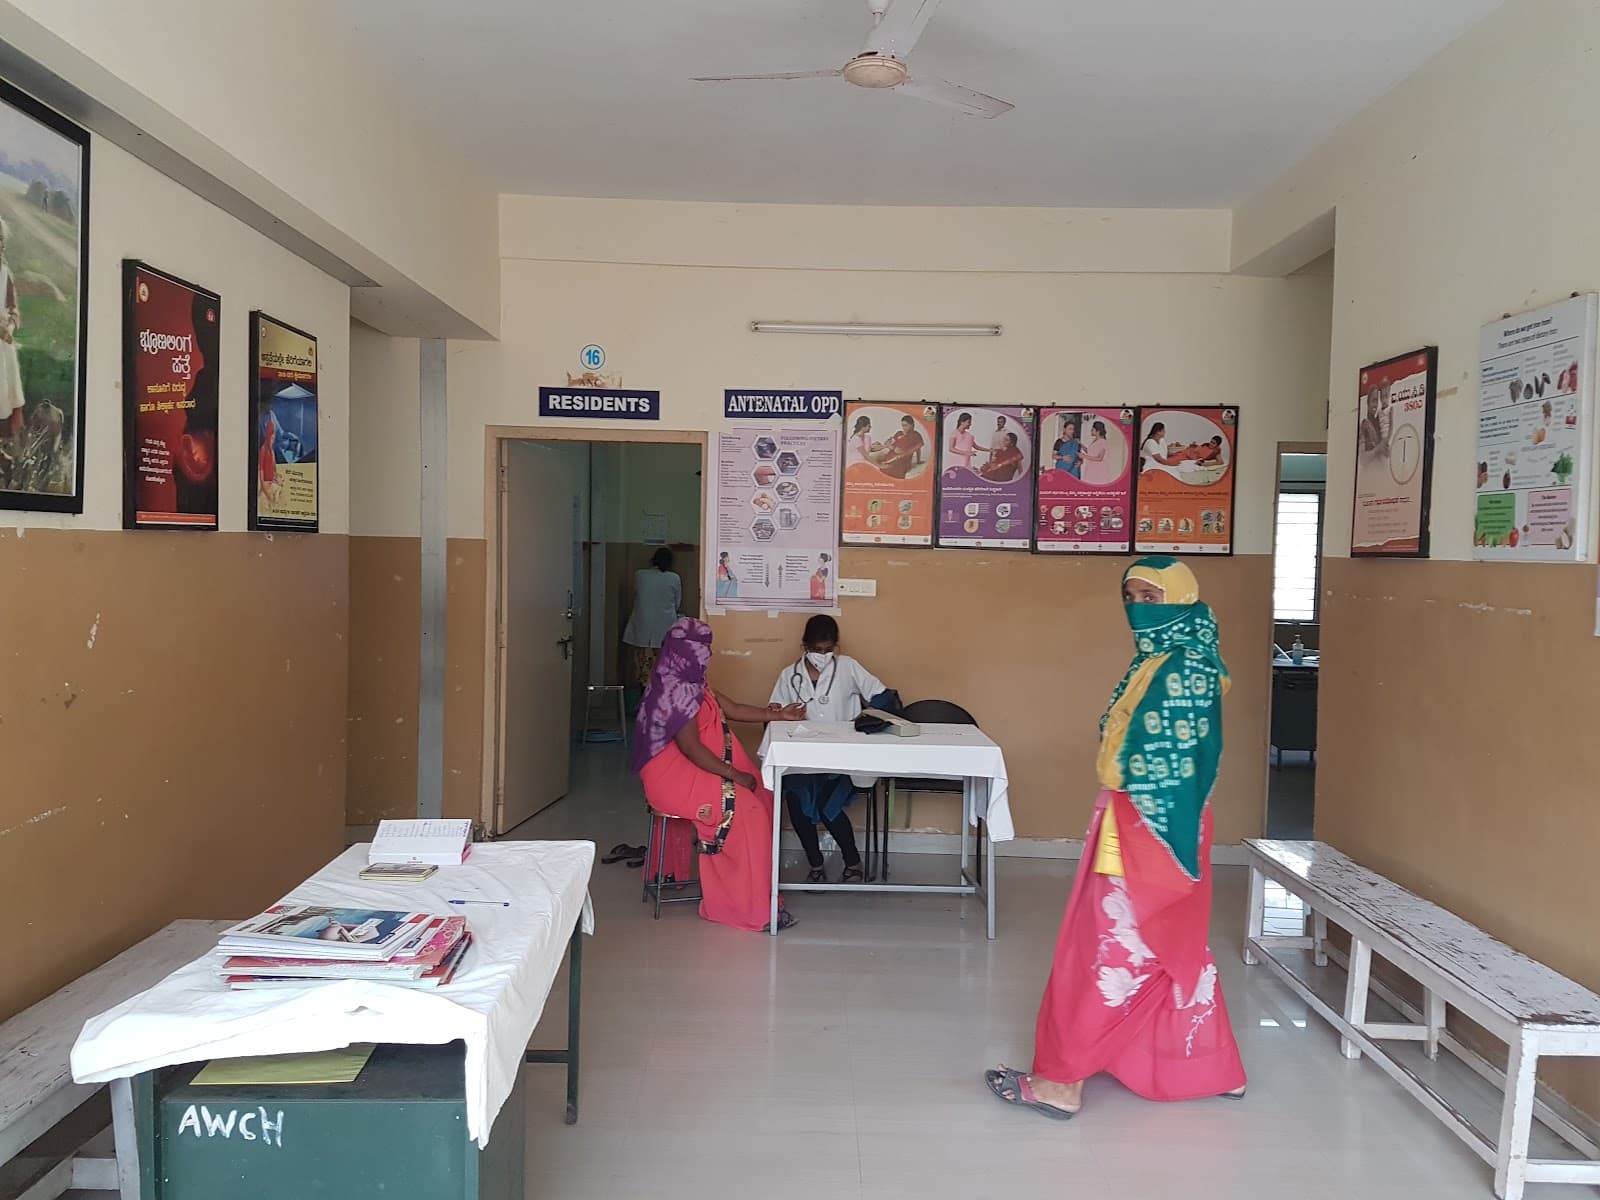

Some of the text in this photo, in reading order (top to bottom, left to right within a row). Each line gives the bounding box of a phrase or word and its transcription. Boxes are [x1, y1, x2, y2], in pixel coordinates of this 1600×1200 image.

[585, 349, 600, 365] 16
[548, 394, 650, 413] RESIDENTS
[728, 395, 840, 414] ANTENATAL OPD
